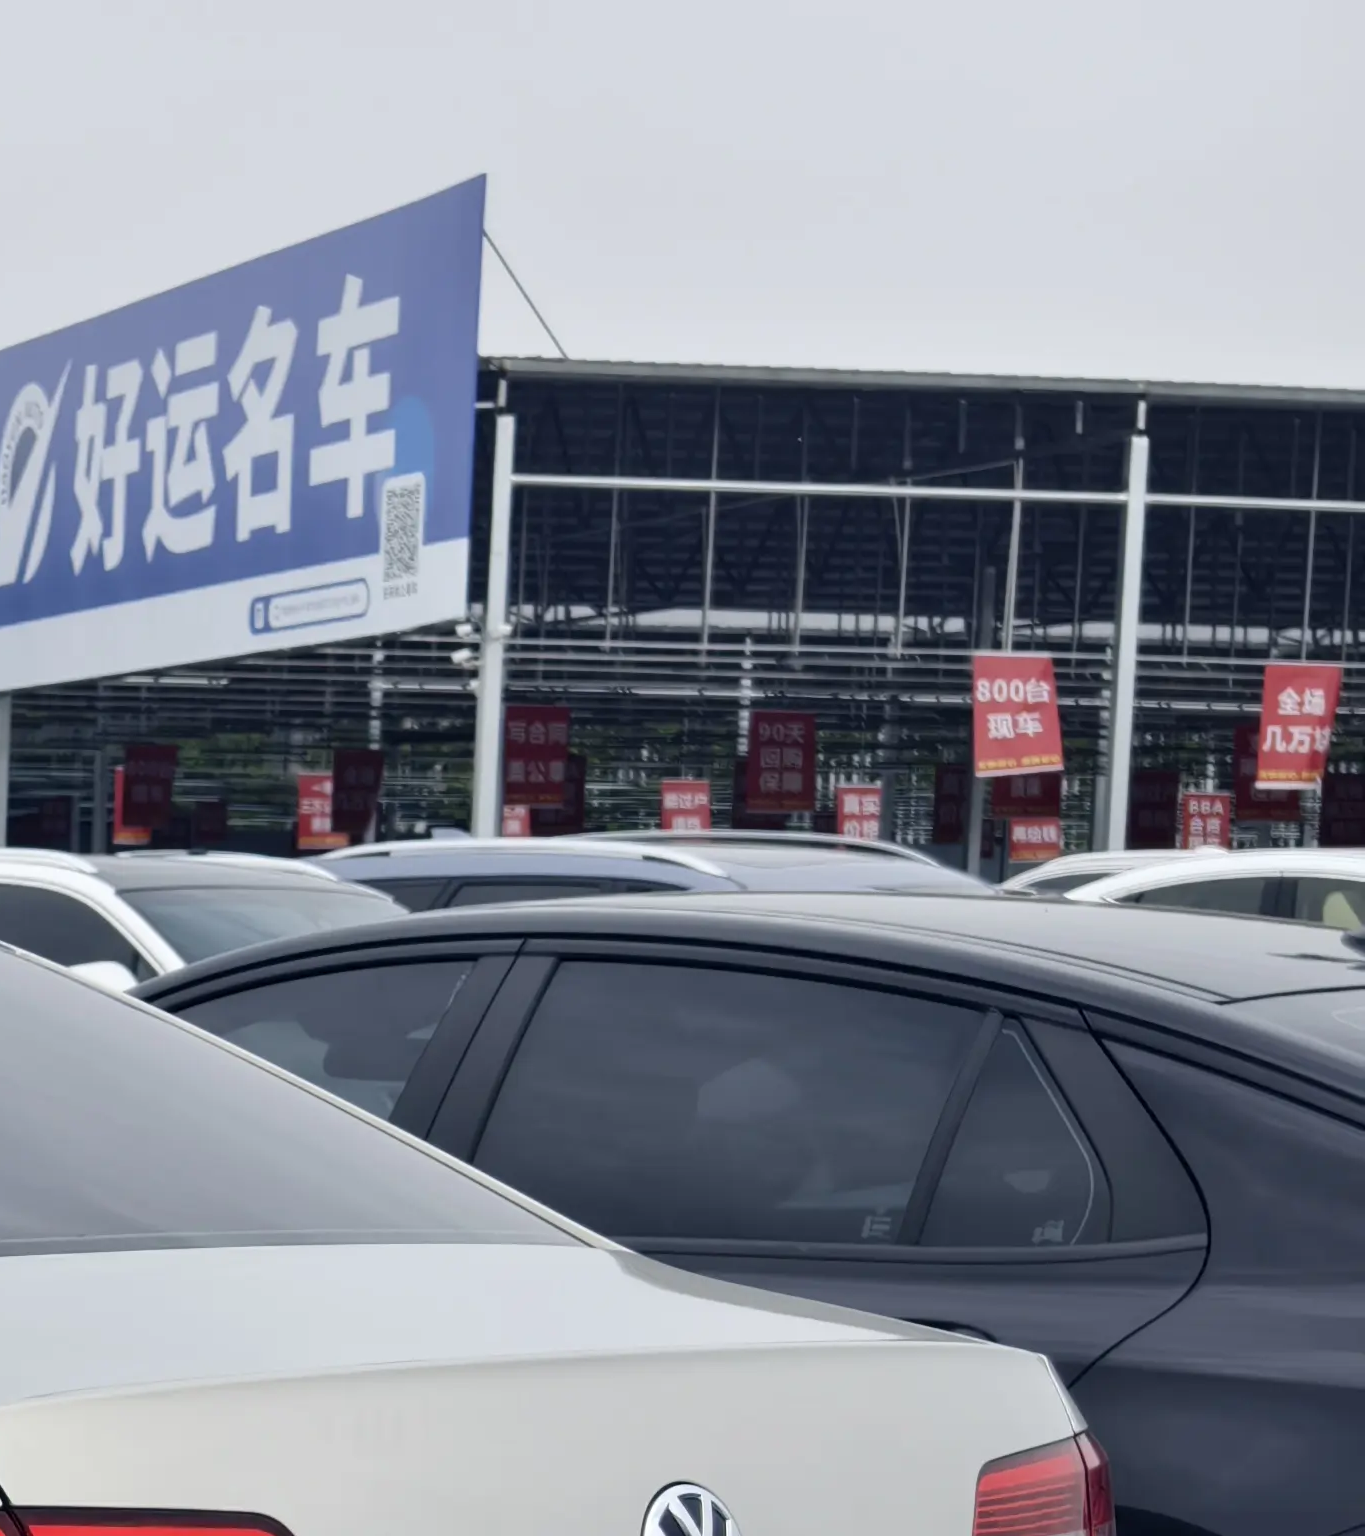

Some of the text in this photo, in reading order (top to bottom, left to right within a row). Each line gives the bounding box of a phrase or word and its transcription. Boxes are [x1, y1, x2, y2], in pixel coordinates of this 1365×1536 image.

[70, 274, 401, 577] 好运名车
[976, 677, 1051, 704] 800台
[1277, 687, 1326, 716] 全场
[758, 721, 806, 744] 90天
[987, 711, 1043, 740] 现车
